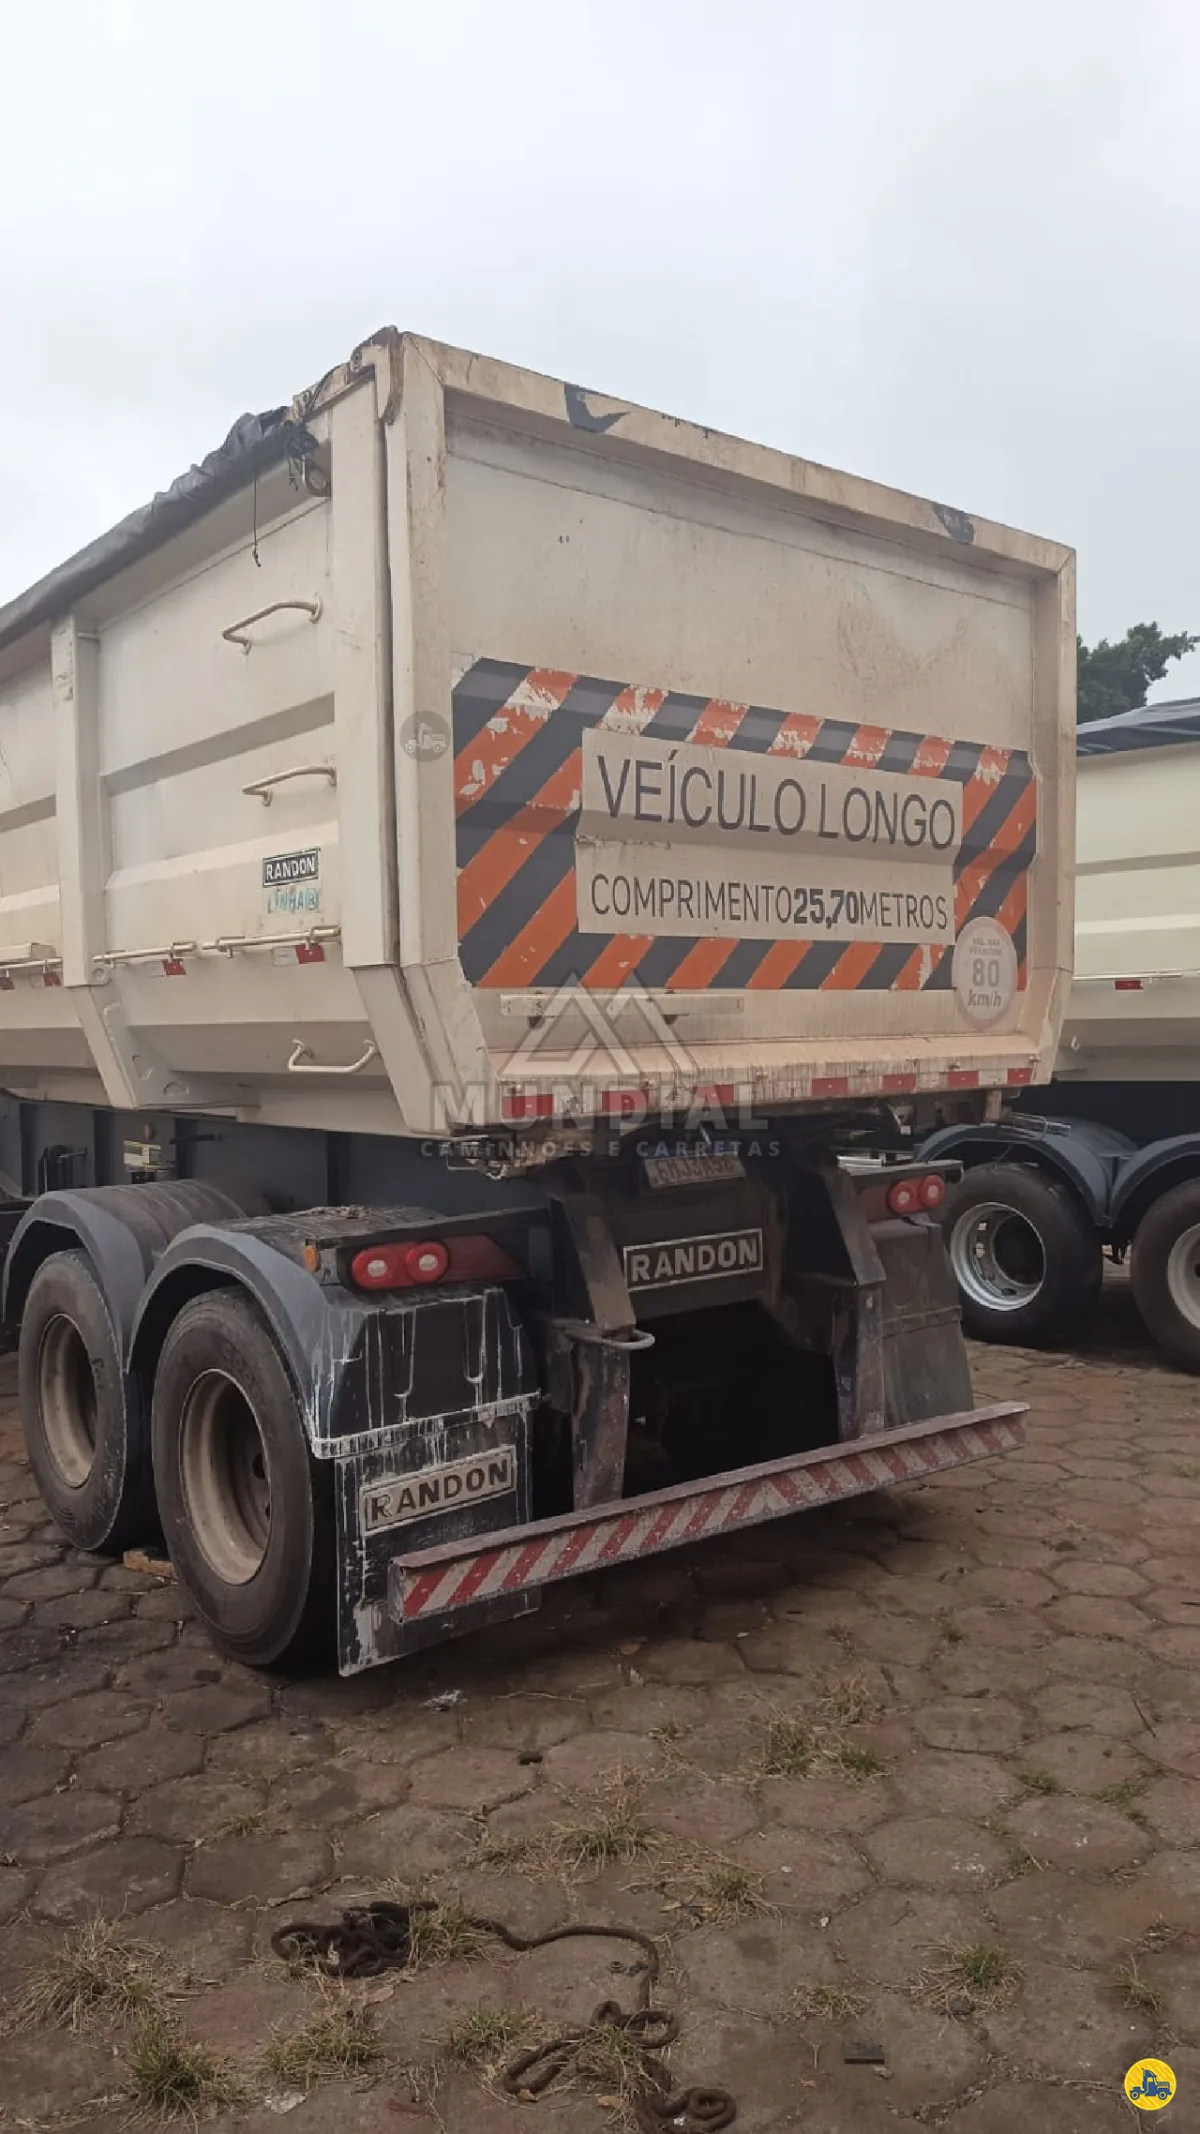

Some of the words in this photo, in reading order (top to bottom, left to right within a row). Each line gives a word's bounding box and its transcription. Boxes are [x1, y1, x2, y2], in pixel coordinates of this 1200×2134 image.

[597, 749, 807, 836] VEÍCULO
[820, 783, 955, 850] LONGO
[266, 856, 315, 880] RANDON
[972, 959, 1000, 987] 80
[967, 989, 1002, 1007] km/h
[630, 1237, 758, 1282] RANDON
[371, 1459, 508, 1521] RANDON
